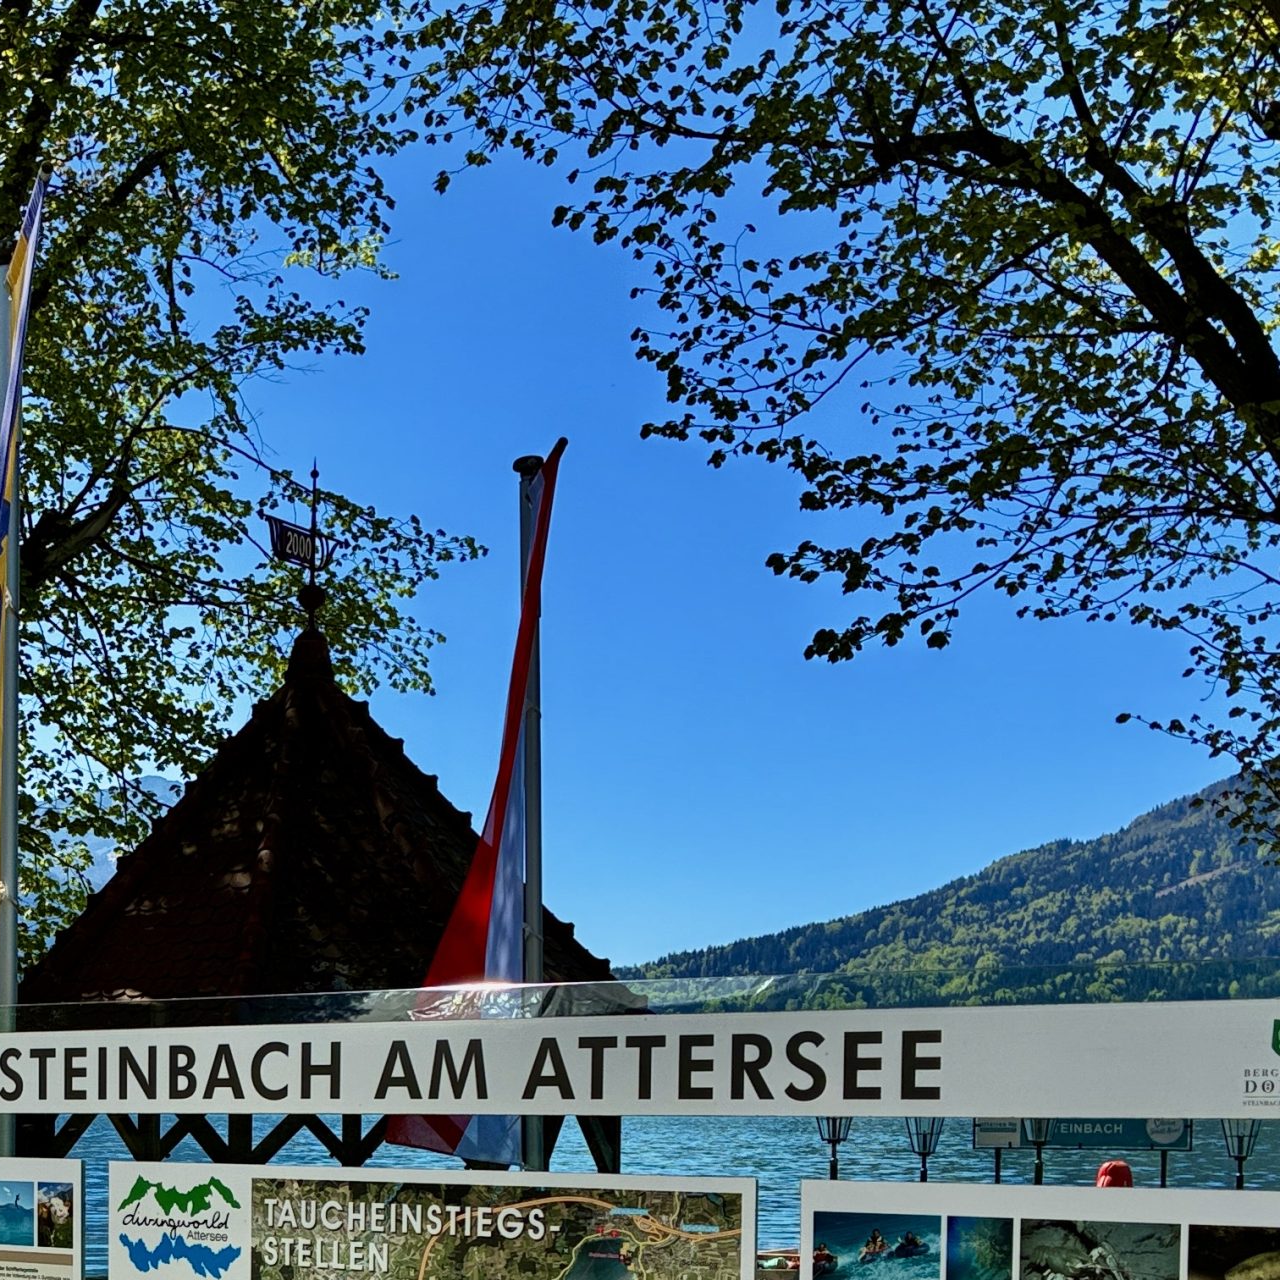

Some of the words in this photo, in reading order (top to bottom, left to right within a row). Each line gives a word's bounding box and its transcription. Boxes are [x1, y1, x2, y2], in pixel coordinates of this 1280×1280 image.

[285, 531, 312, 560] 2000
[0, 1041, 341, 1101] STEINBACH
[373, 1038, 489, 1100] AM
[522, 1029, 942, 1102] ATTERSEE
[122, 1201, 230, 1241] divingworld
[186, 1230, 228, 1242] Attersee
[263, 1198, 561, 1241] TAUCHEINSTIEGS-
[263, 1236, 390, 1273] STELLEN
